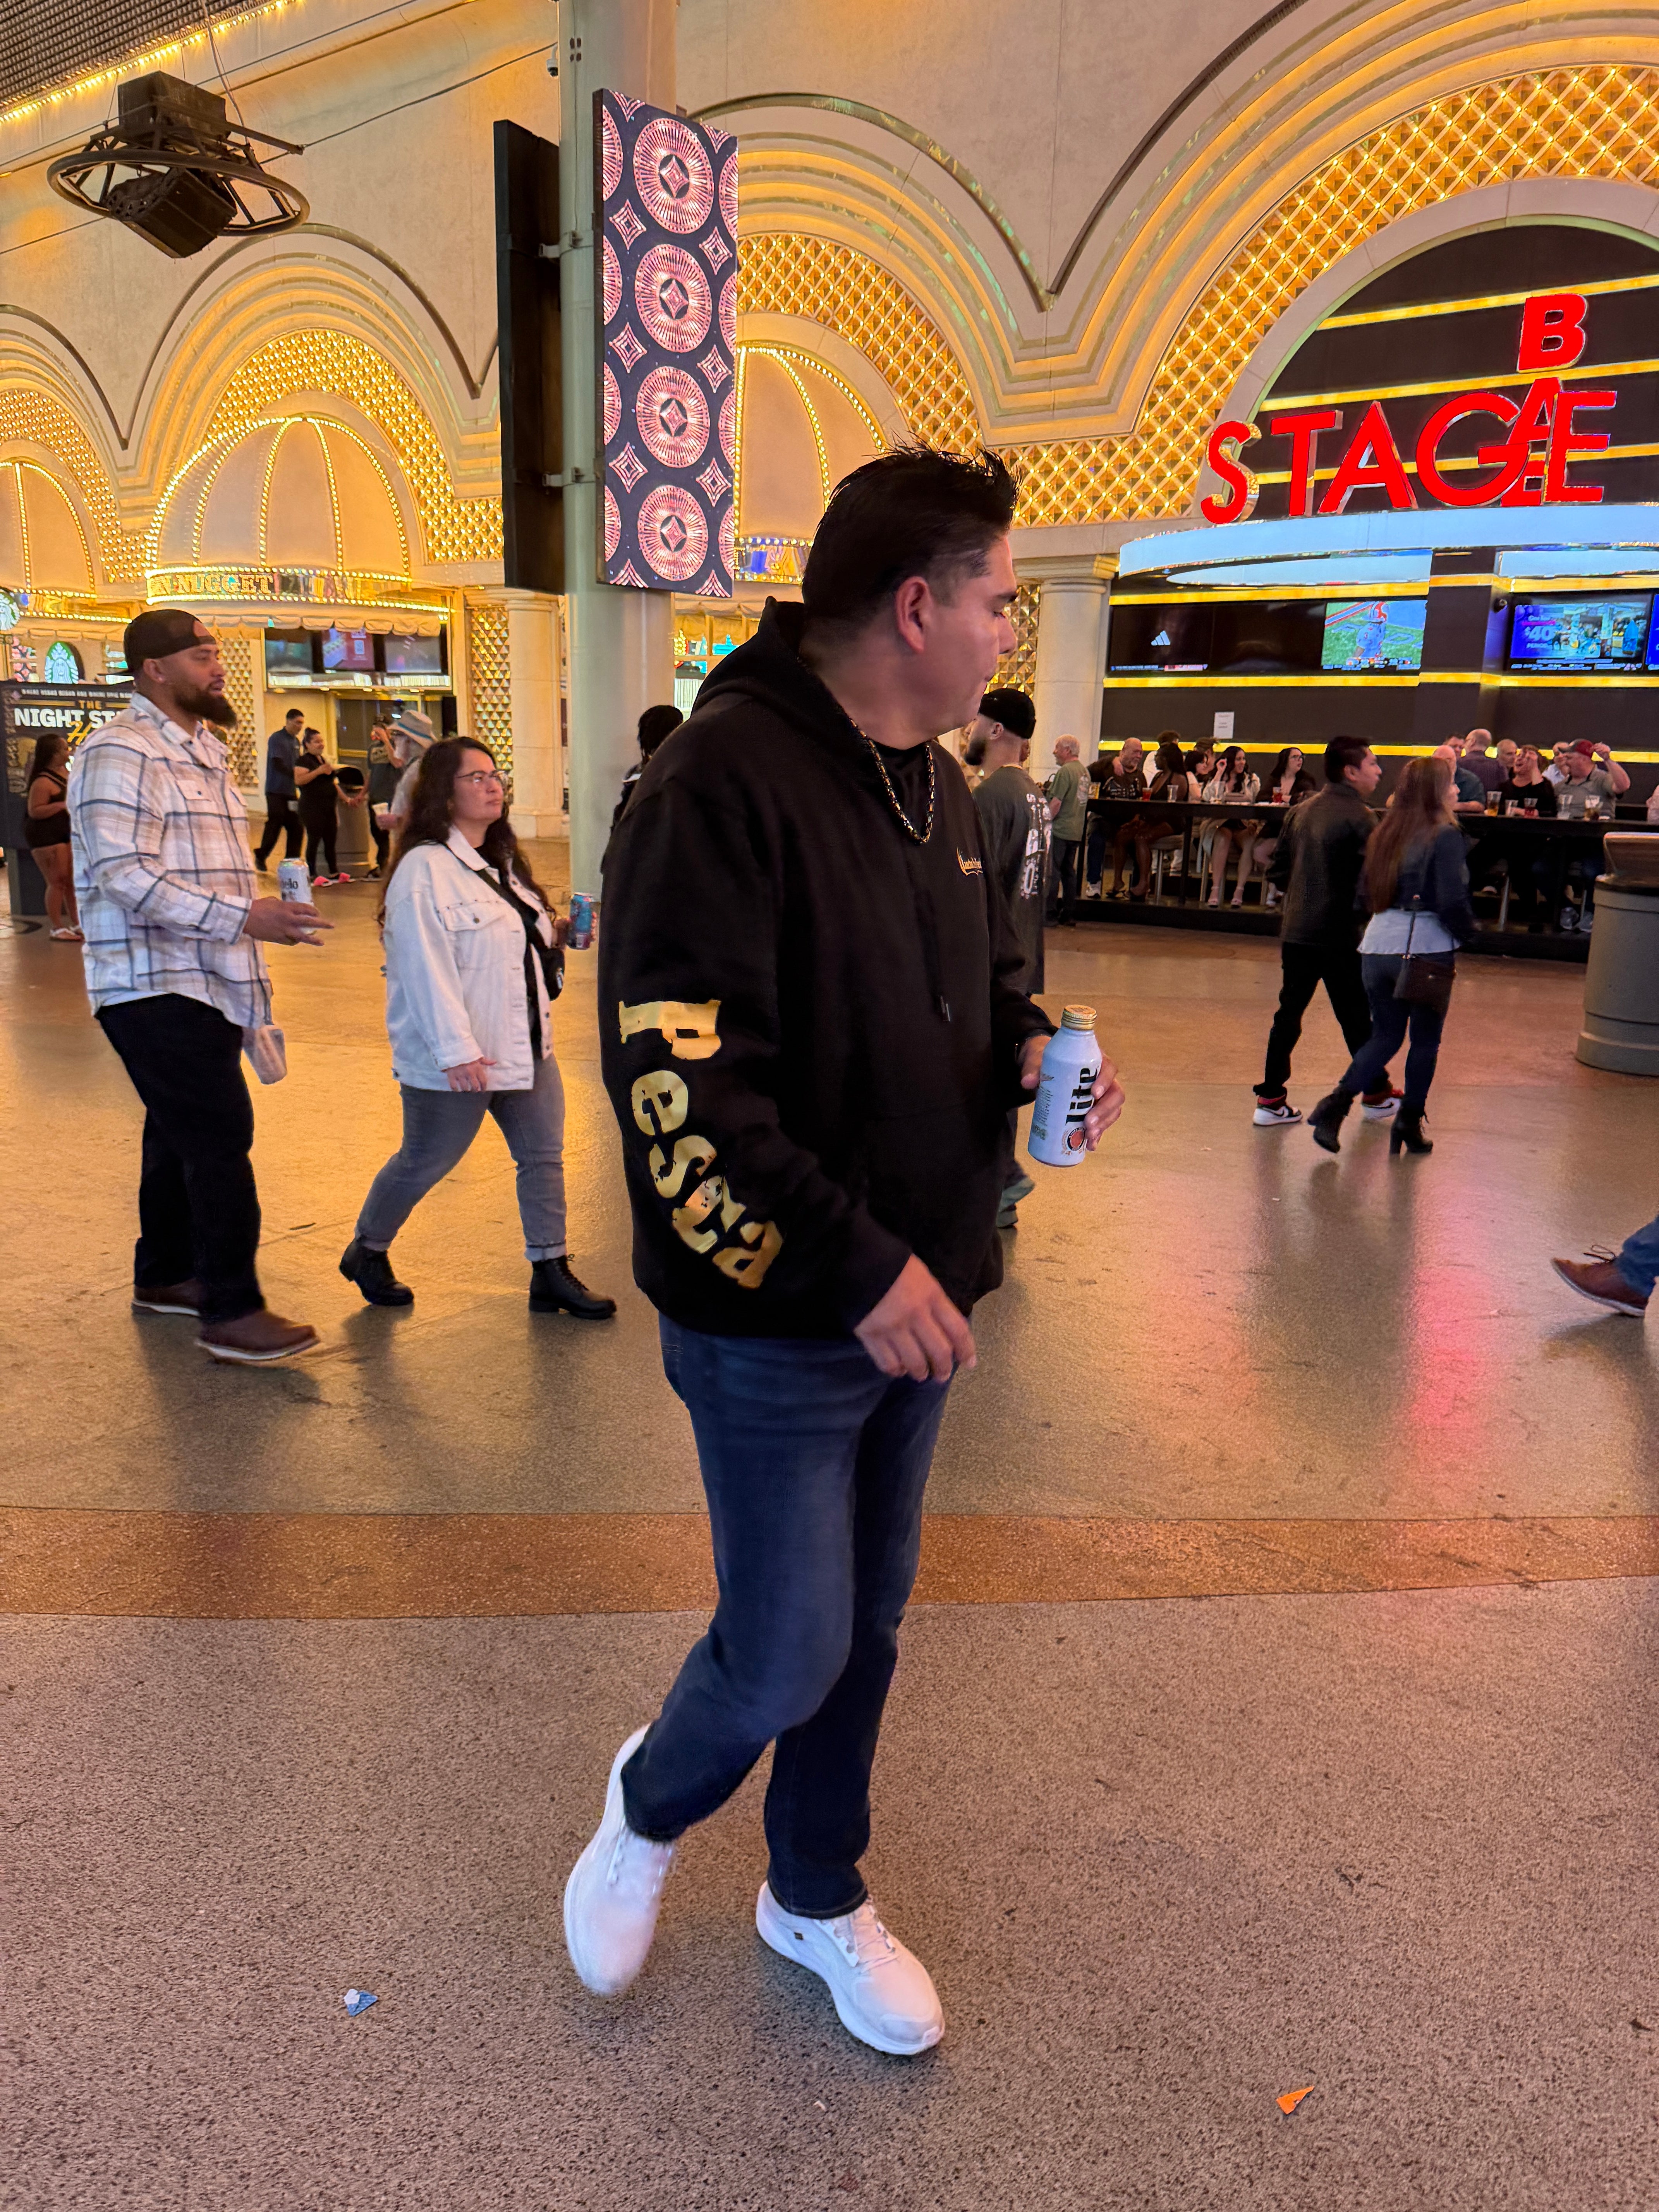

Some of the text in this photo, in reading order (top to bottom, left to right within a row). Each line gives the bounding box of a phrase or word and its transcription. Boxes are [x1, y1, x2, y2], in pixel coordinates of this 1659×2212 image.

[1201, 390, 1618, 524] STAGE
[176, 574, 273, 594] NUGGET
[79, 700, 102, 710] THE
[14, 708, 84, 728] NIGHT
[1065, 1068, 1097, 1126] lite
